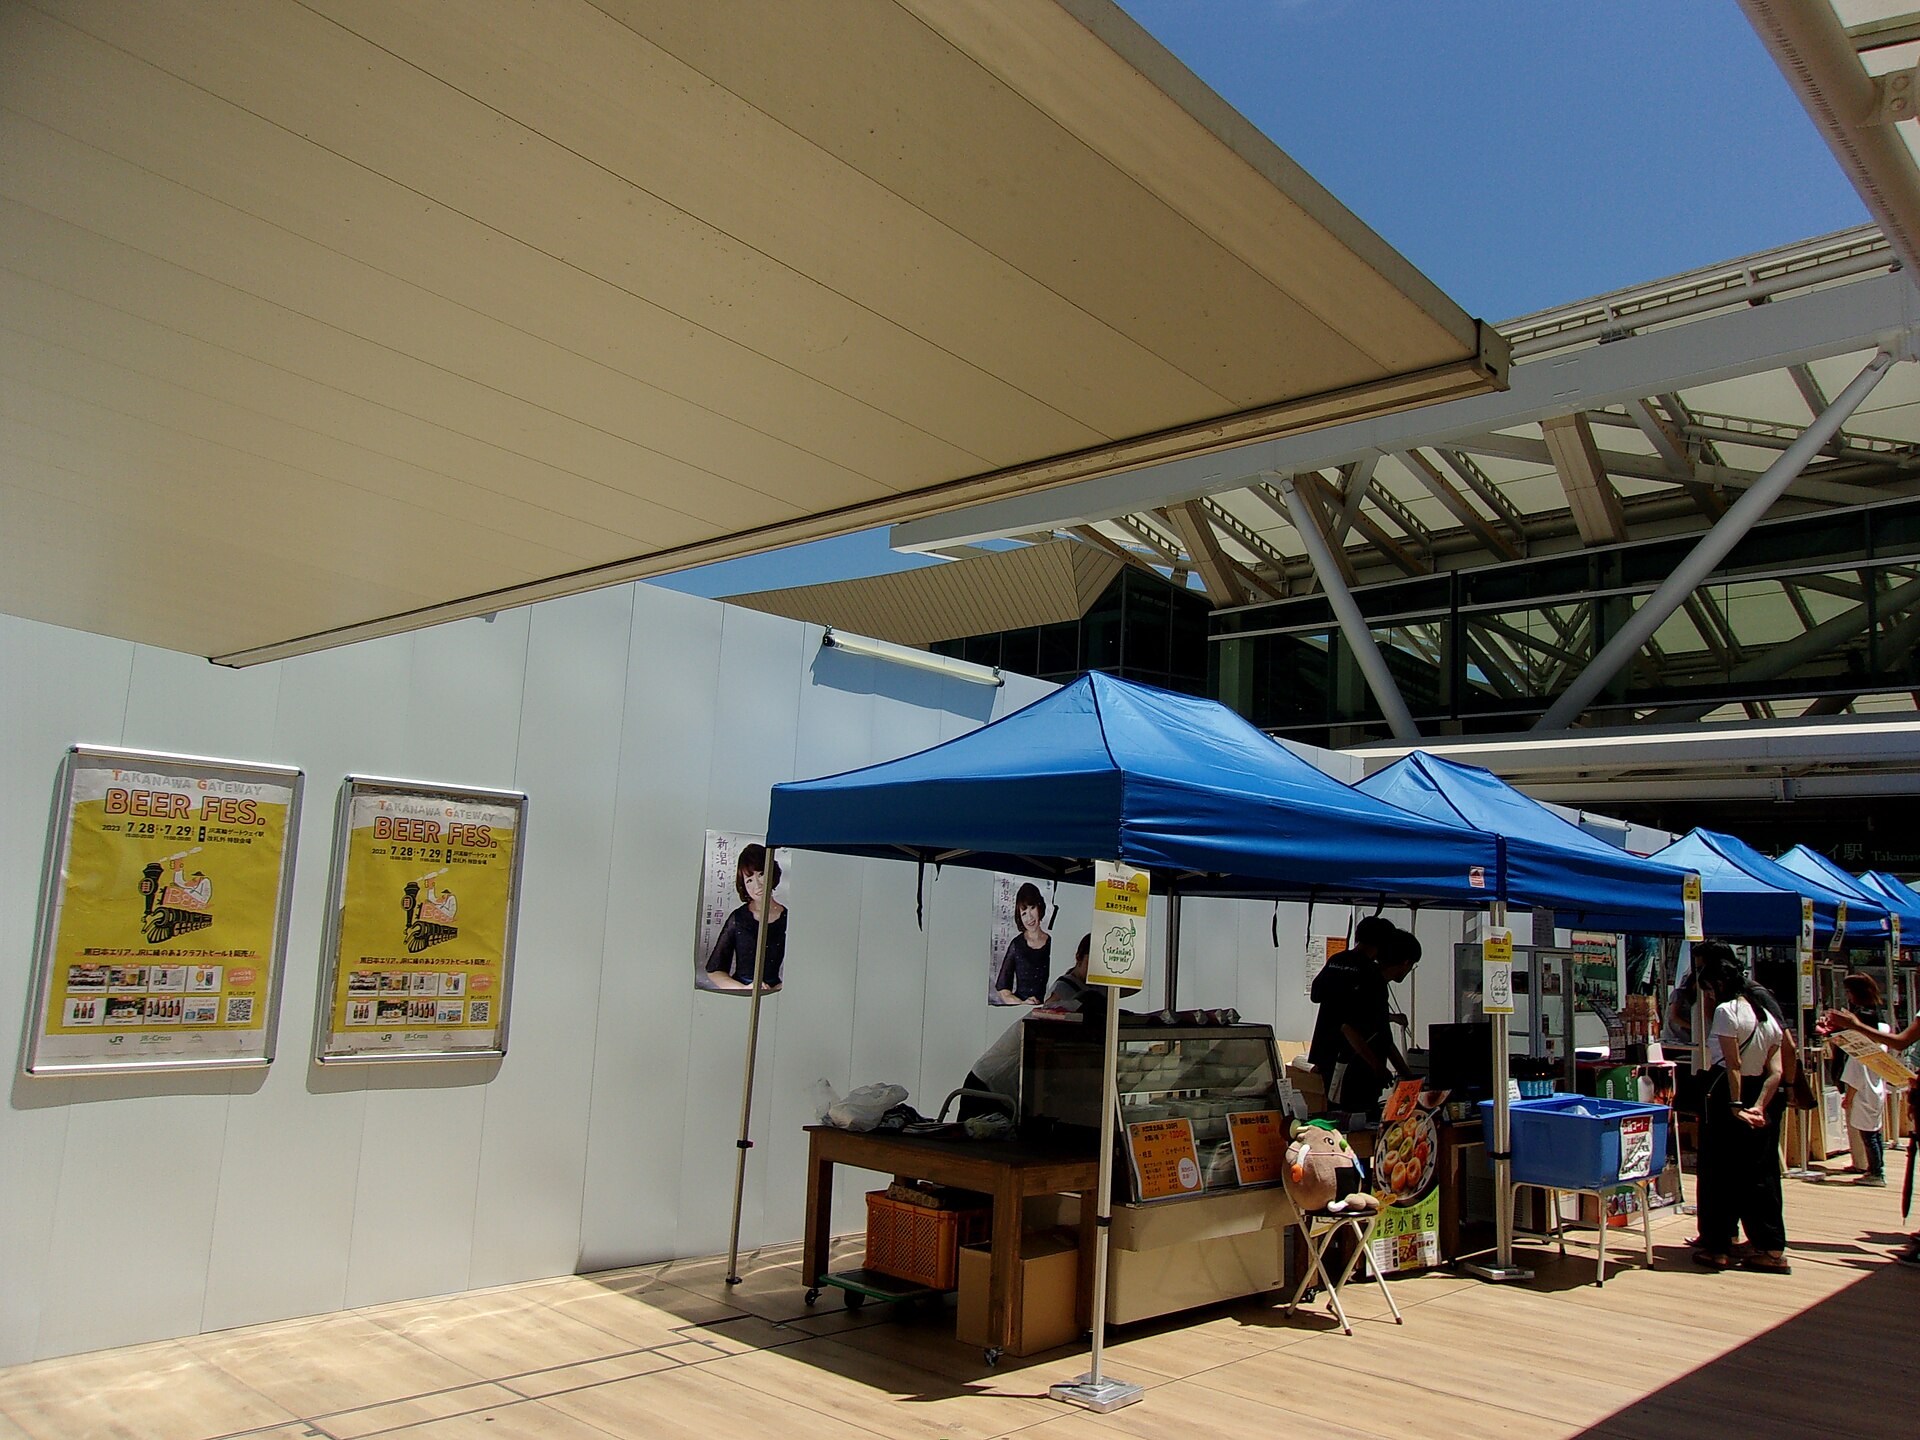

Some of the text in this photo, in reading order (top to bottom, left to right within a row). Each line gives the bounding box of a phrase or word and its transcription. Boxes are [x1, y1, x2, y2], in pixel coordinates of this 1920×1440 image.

[112, 769, 262, 796] TAKANAWA GATEWAY
[105, 788, 266, 826] BEER FES.
[379, 800, 496, 822] TAKANAWA GATEWAY
[373, 816, 498, 849] BEER FES.
[1107, 879, 1125, 890] BEER
[109, 1035, 124, 1044] JR
[381, 1033, 392, 1041] JR
